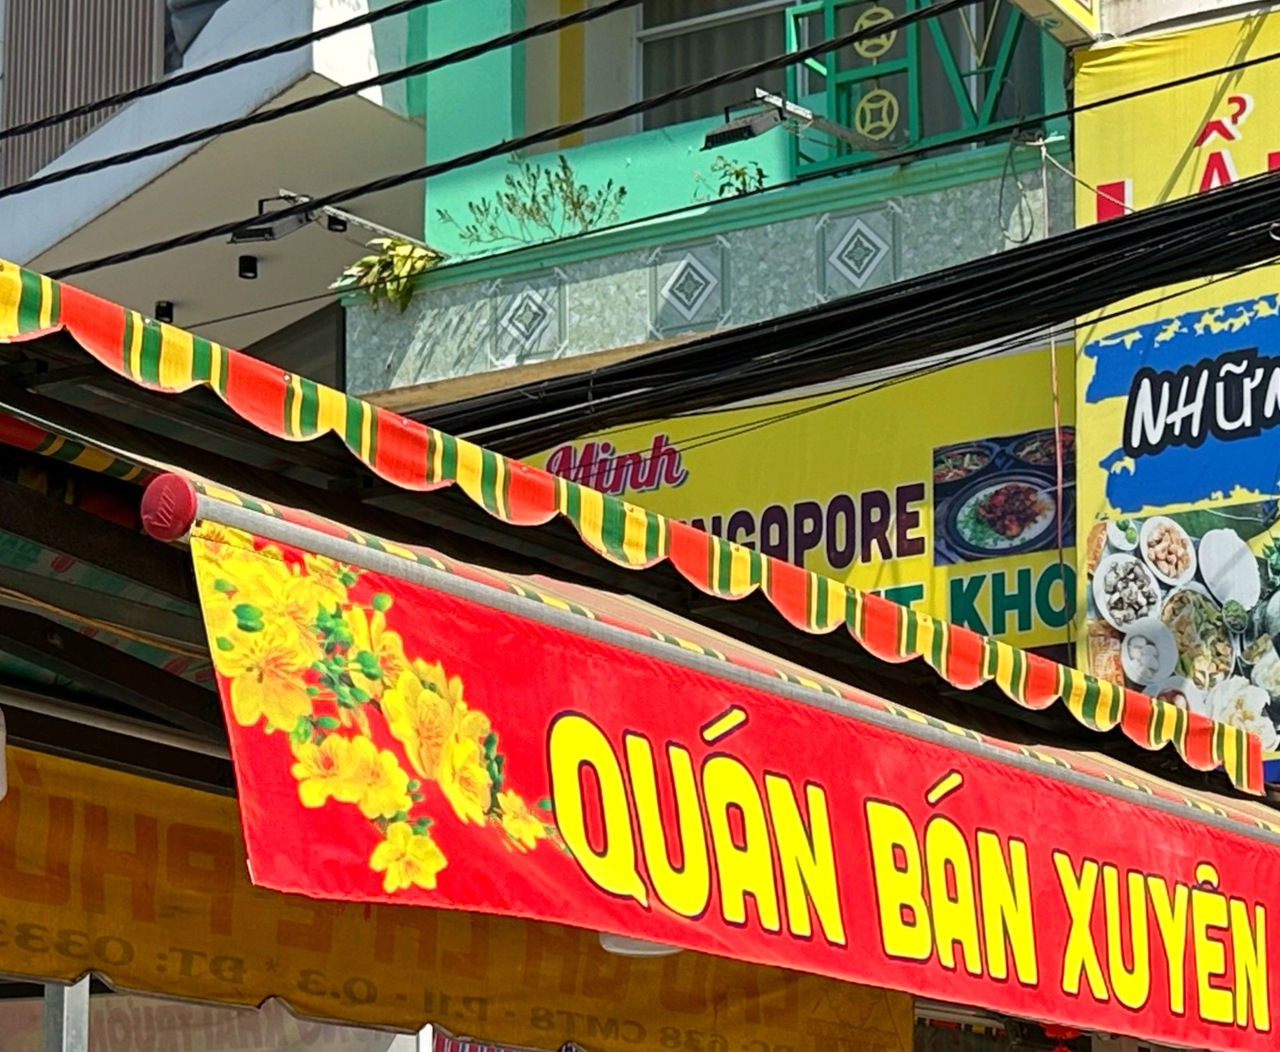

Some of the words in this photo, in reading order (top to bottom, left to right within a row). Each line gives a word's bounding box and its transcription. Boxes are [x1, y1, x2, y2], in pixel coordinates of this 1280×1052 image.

[546, 432, 690, 495] Minh
[949, 562, 1076, 634] KHO
[547, 705, 847, 948] QUÁN
[865, 770, 1039, 986] BÁN
[1052, 863, 1271, 1033] XUYÊN
